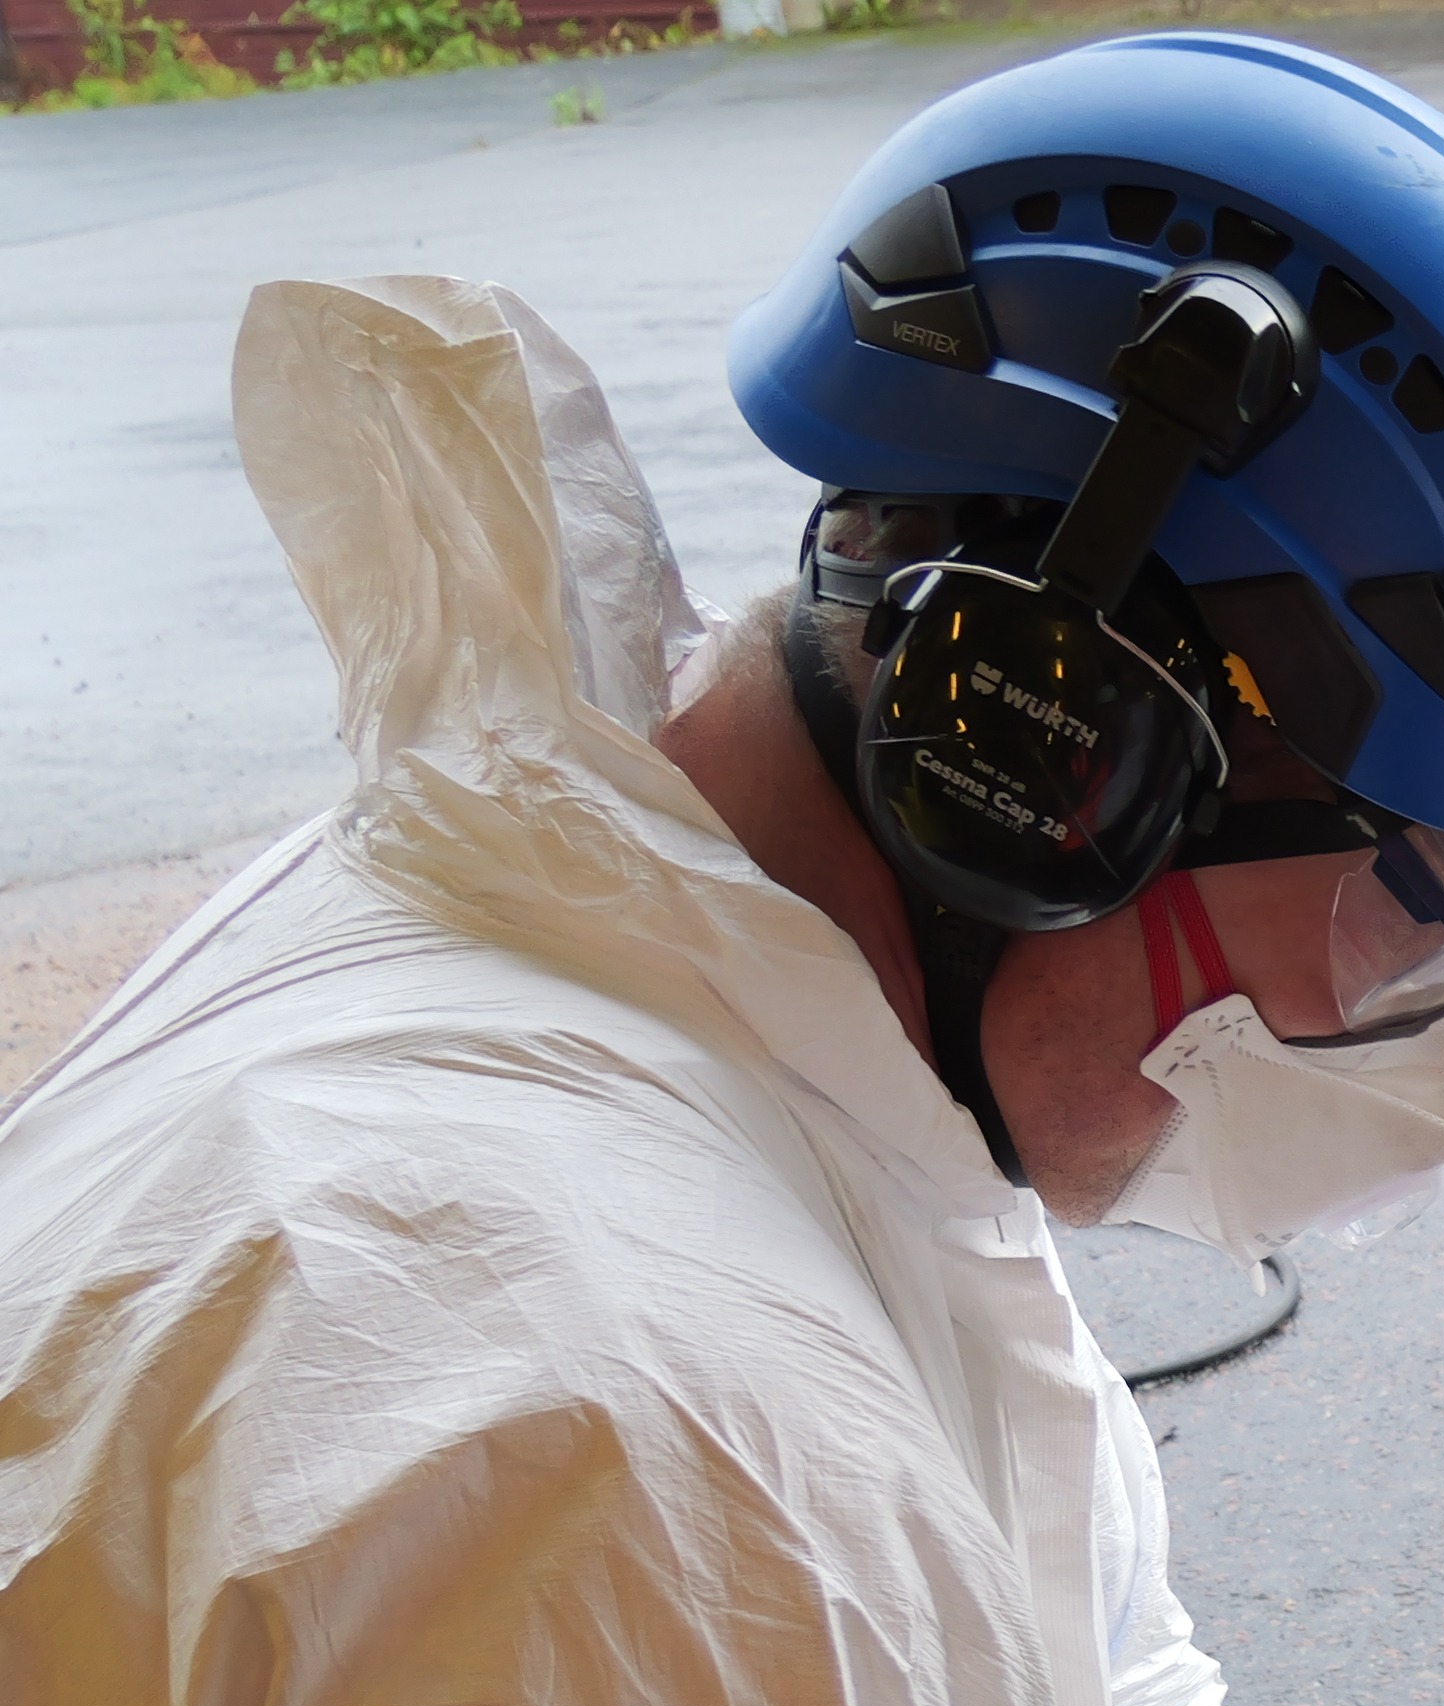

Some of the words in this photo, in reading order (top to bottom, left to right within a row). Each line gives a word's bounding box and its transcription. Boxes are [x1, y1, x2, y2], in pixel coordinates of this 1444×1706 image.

[893, 320, 960, 356] VERTEX
[1003, 682, 1100, 749] WÜRTH
[971, 758, 995, 777] SNR
[915, 750, 988, 800] Cessna
[993, 791, 1036, 826] Cap
[1038, 816, 1069, 842] 28
